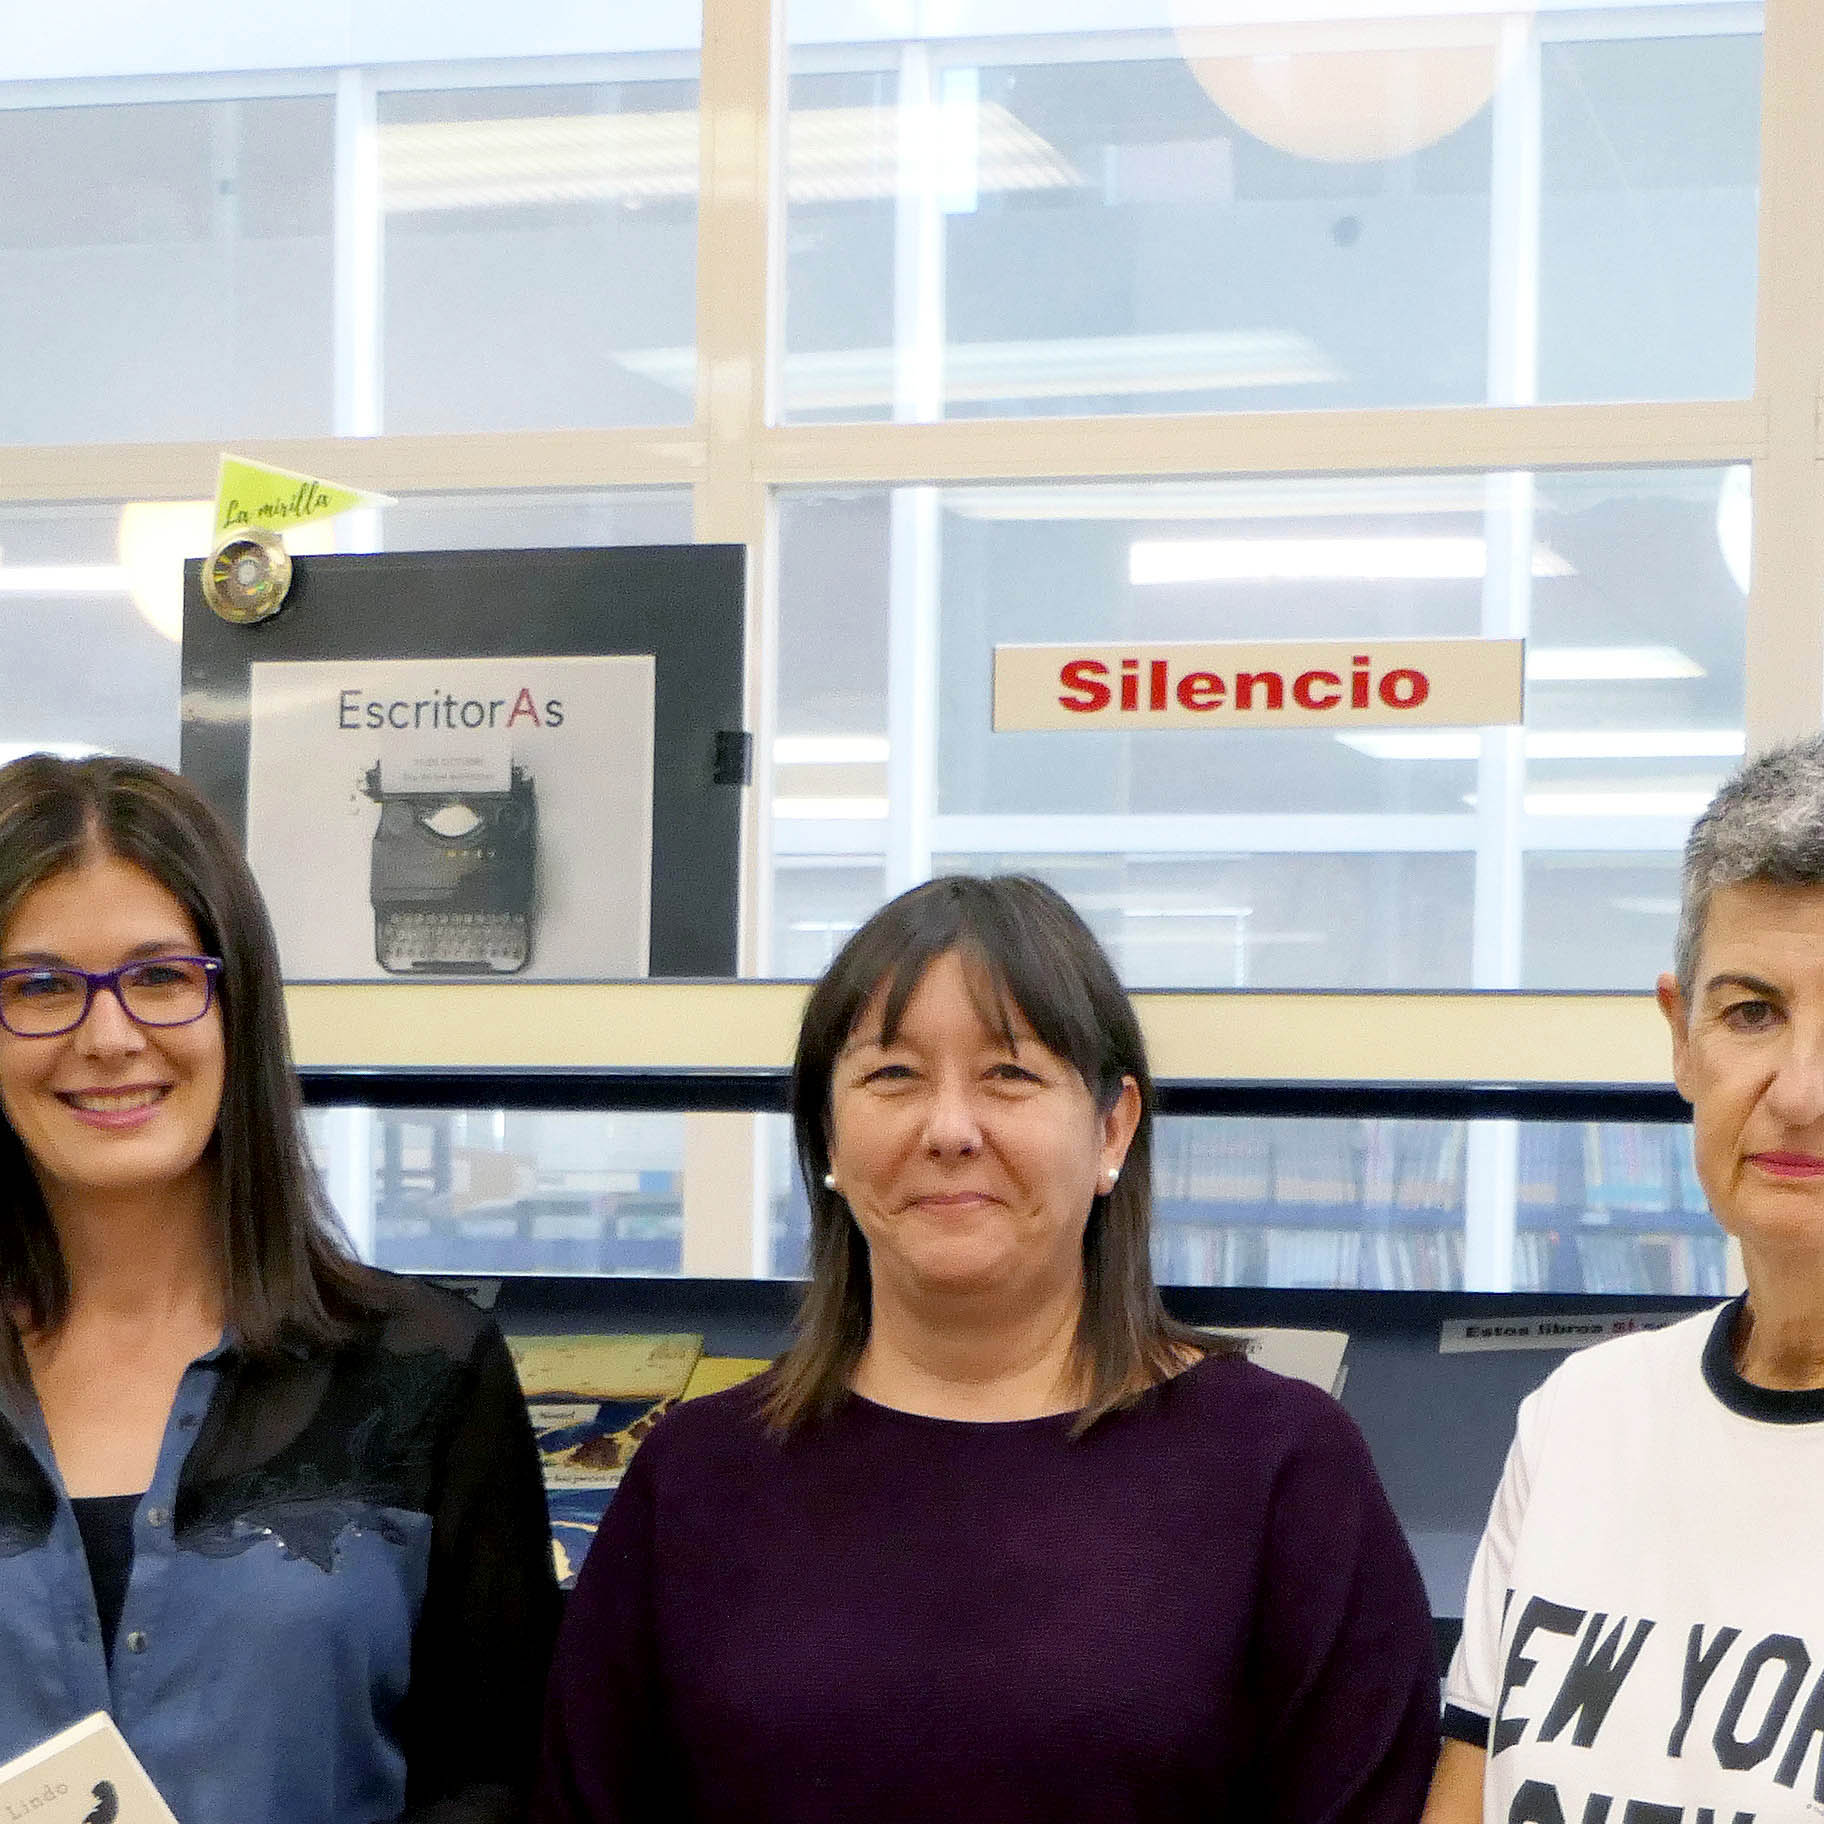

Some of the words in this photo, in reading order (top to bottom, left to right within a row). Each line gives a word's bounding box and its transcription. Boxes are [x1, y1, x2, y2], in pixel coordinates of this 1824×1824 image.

[224, 500, 248, 528] La
[258, 481, 331, 518] mirilla
[1058, 656, 1429, 713] Silencio
[339, 688, 564, 729] EscritorAs
[1465, 1326, 1530, 1339] Estos
[1538, 1323, 1604, 1335] libros
[1492, 1588, 1656, 1759] EW
[6, 1784, 68, 1820] Lindo
